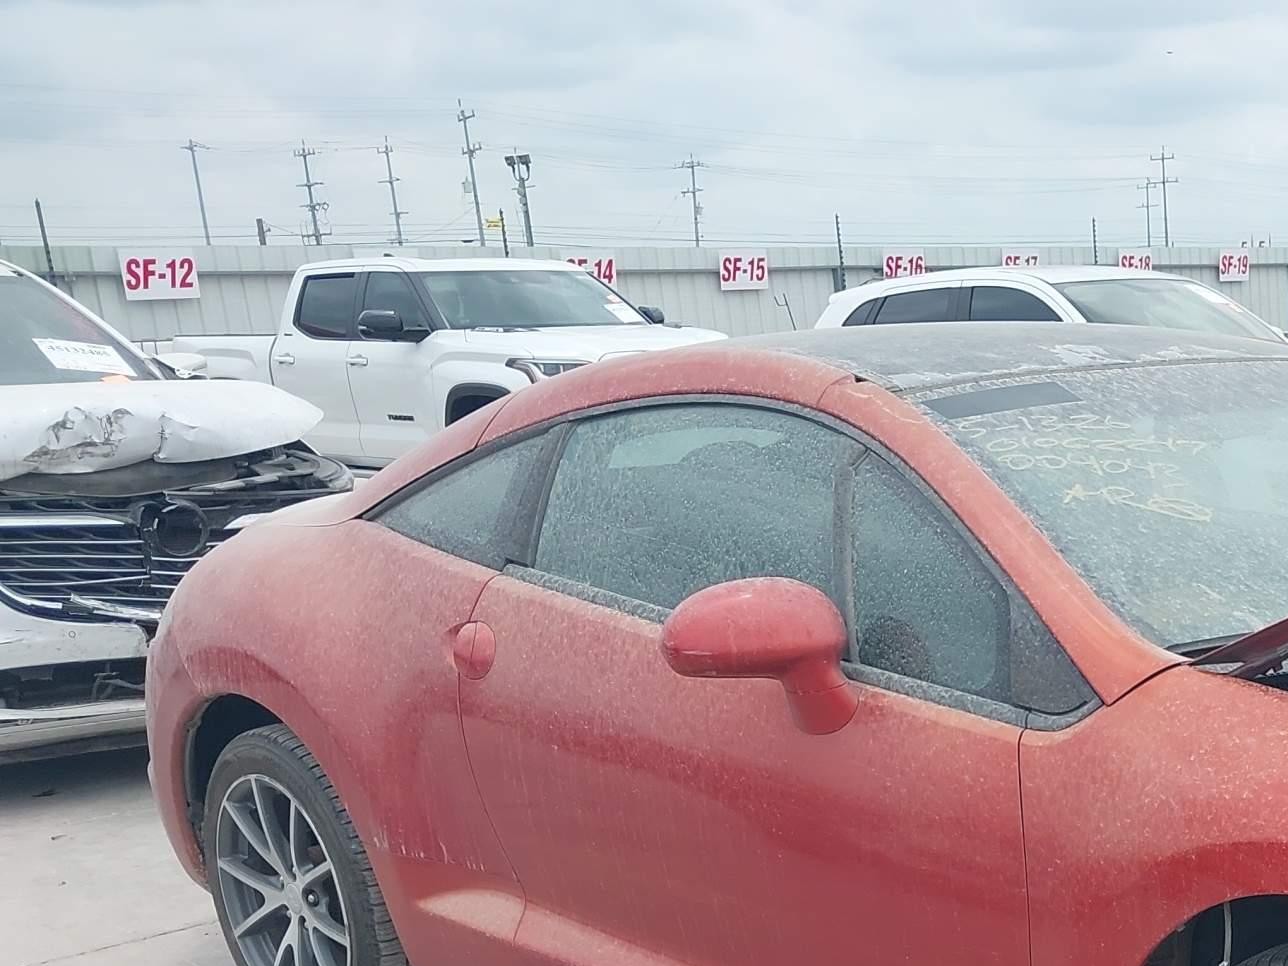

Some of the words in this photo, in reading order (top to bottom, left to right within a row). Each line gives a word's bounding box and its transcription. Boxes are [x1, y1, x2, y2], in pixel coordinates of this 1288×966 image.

[125, 258, 194, 290] SF-12
[721, 257, 766, 282] SF-15
[1220, 254, 1249, 275] SF-19
